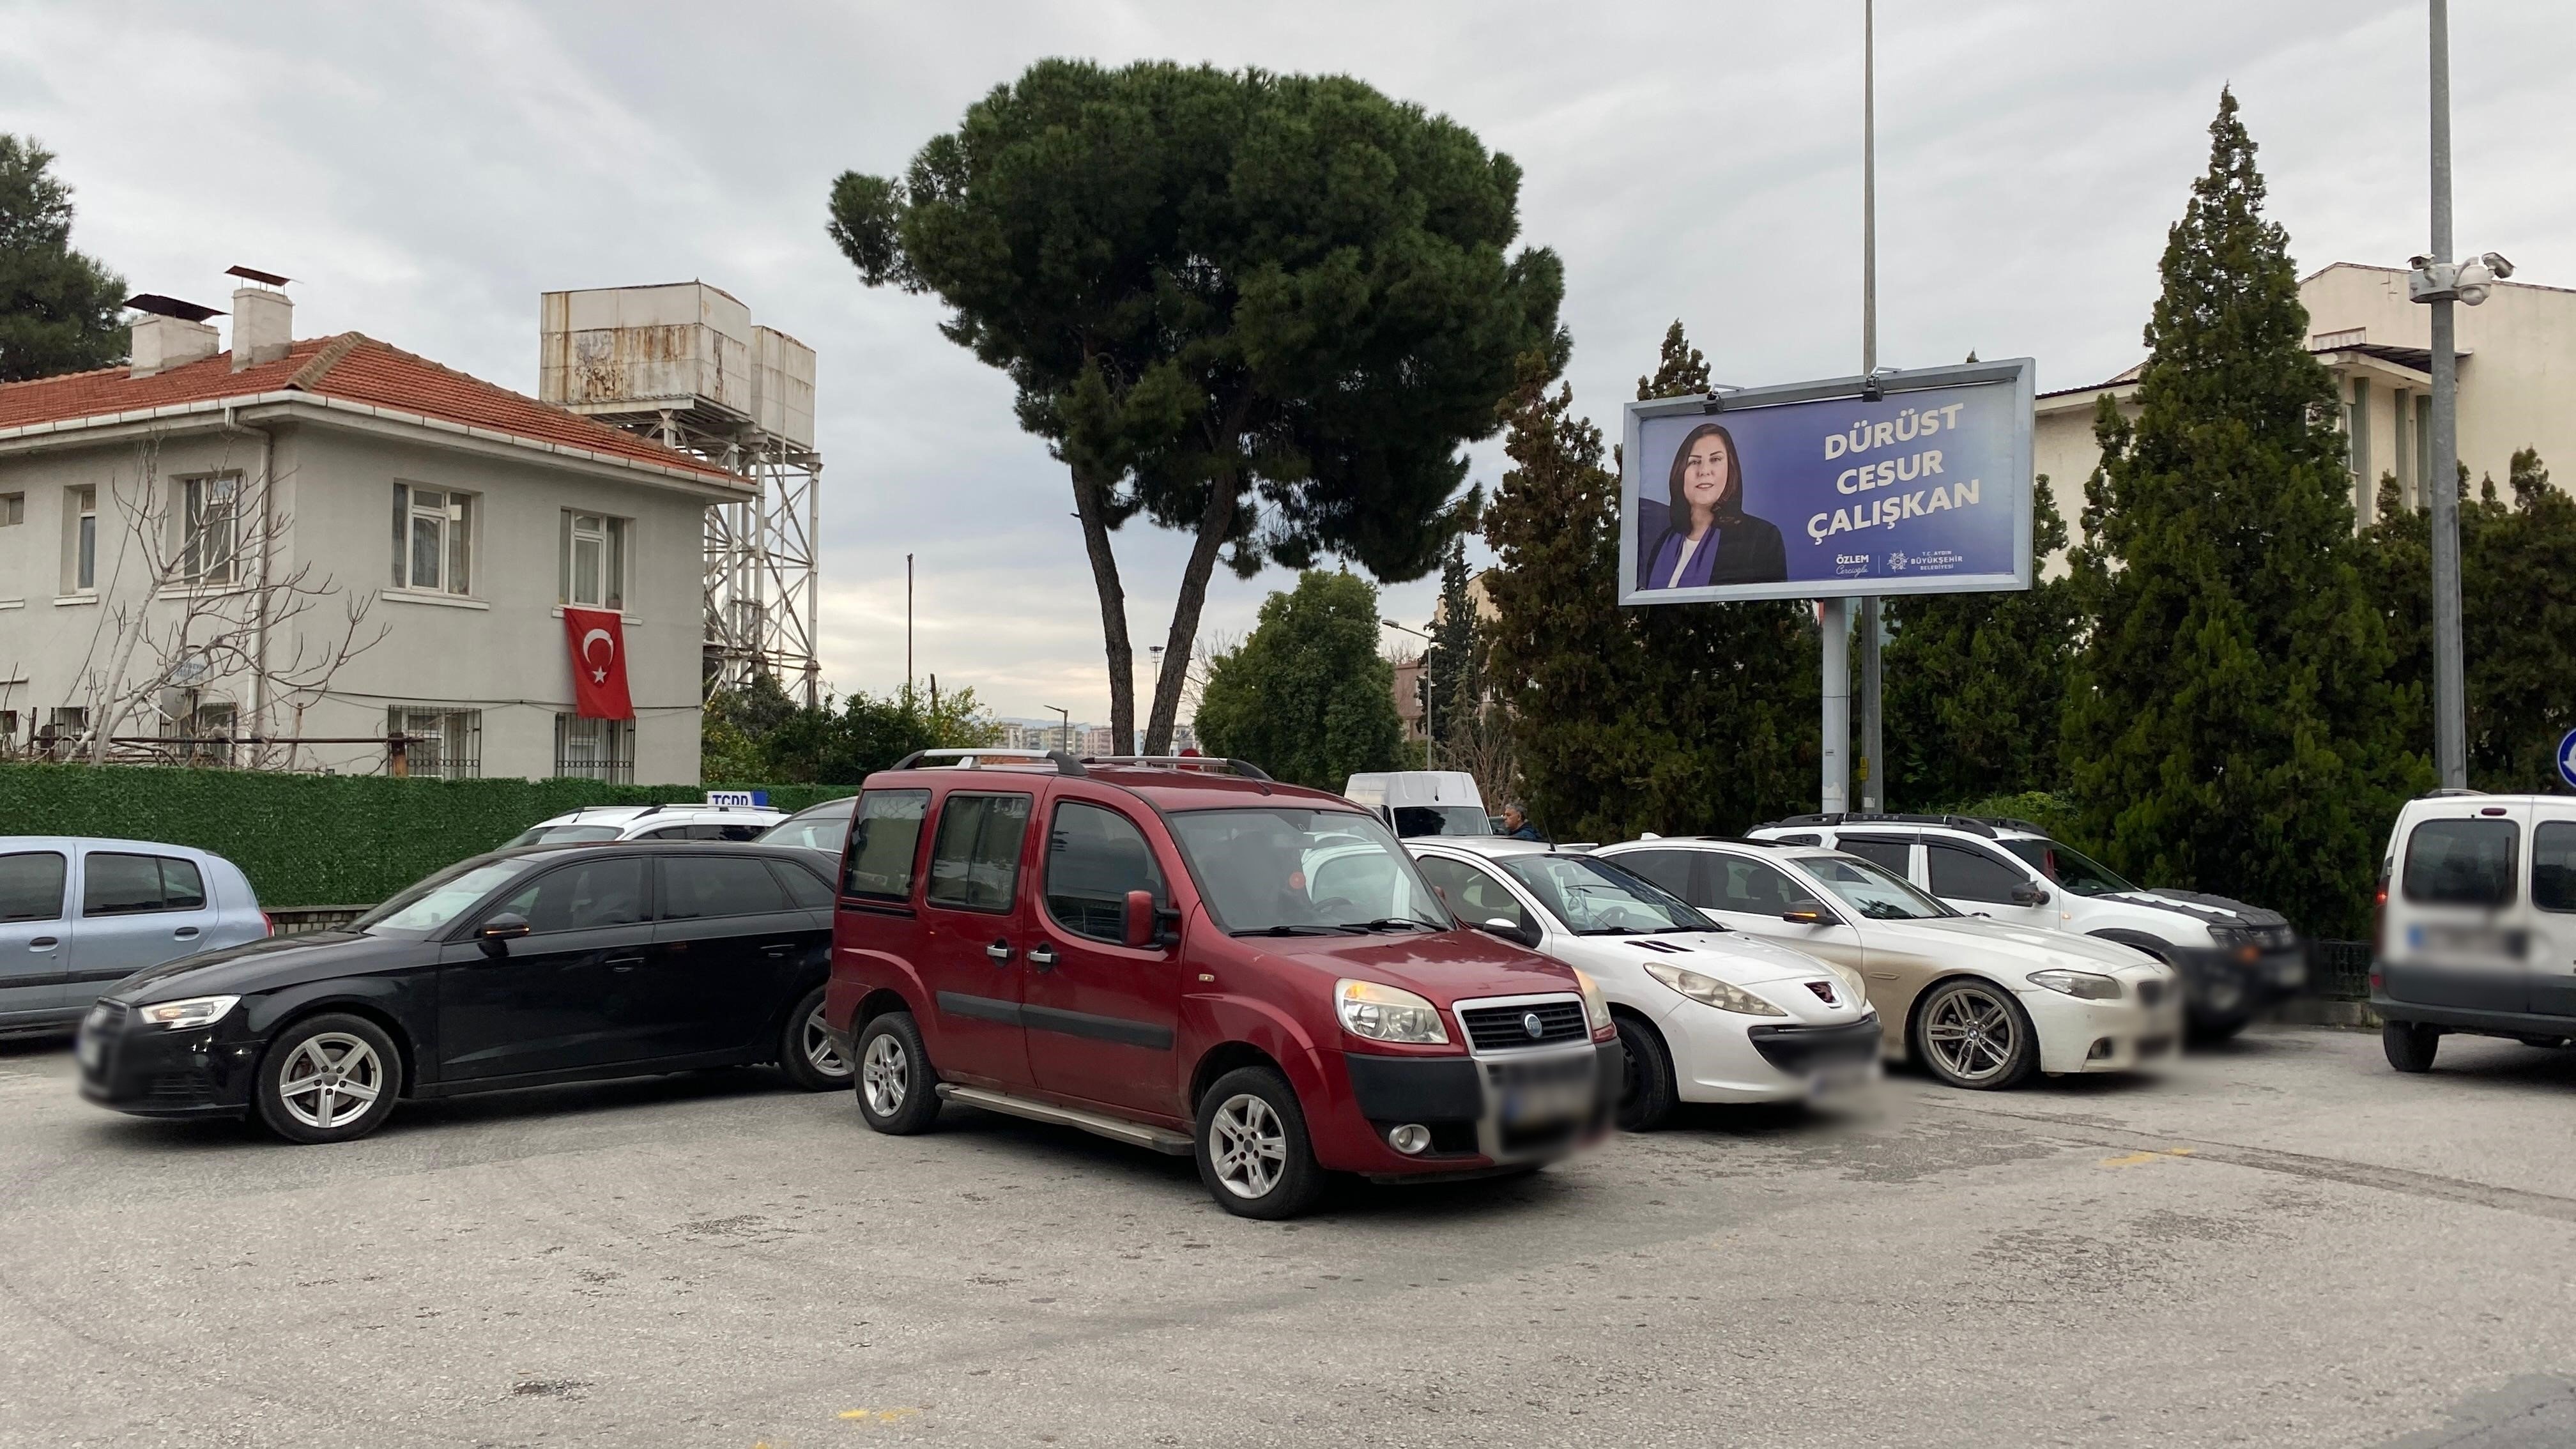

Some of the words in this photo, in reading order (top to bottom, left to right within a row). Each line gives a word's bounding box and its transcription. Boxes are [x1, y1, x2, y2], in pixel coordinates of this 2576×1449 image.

[1825, 402, 1963, 461] DÜRÜST
[1836, 450, 1944, 495] CESUR
[1807, 479, 1979, 546] ÇALIŞKAN
[1836, 554, 1869, 564] ÖZLEM
[1911, 555, 1963, 565] BÜYÜKŞEHİR
[712, 795, 748, 806] TCDD
